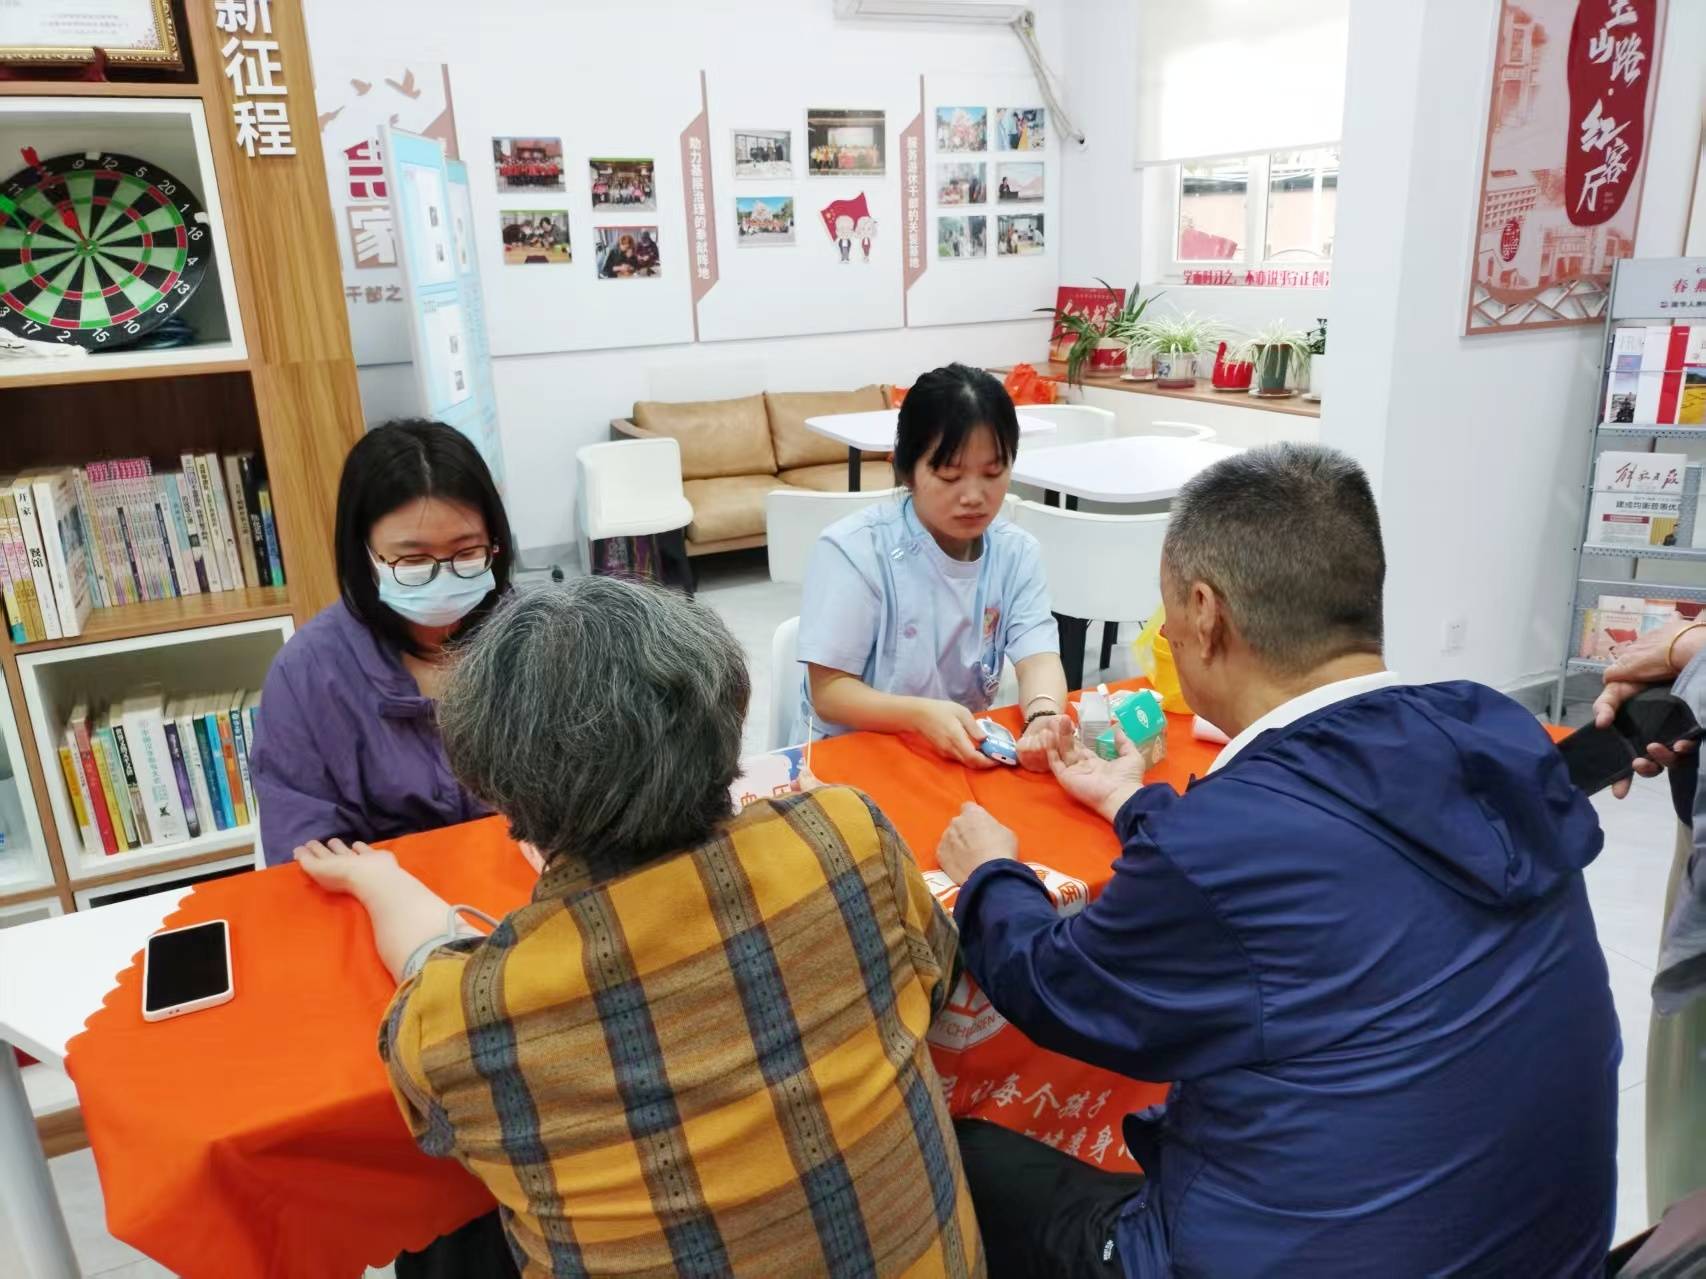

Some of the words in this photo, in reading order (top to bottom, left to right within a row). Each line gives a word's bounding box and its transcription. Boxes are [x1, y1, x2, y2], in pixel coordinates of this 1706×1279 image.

[214, 0, 297, 158] 新征程
[101, 157, 119, 169] 12
[135, 167, 147, 178] 5
[157, 180, 176, 195] 20
[180, 203, 190, 213] 1
[187, 226, 203, 241] 18
[187, 256, 199, 267] 4
[173, 279, 191, 295] 13
[155, 302, 168, 313] 6
[22, 319, 42, 335] 17
[123, 319, 140, 335] 10
[56, 330, 71, 343] 2
[92, 327, 110, 343] 15
